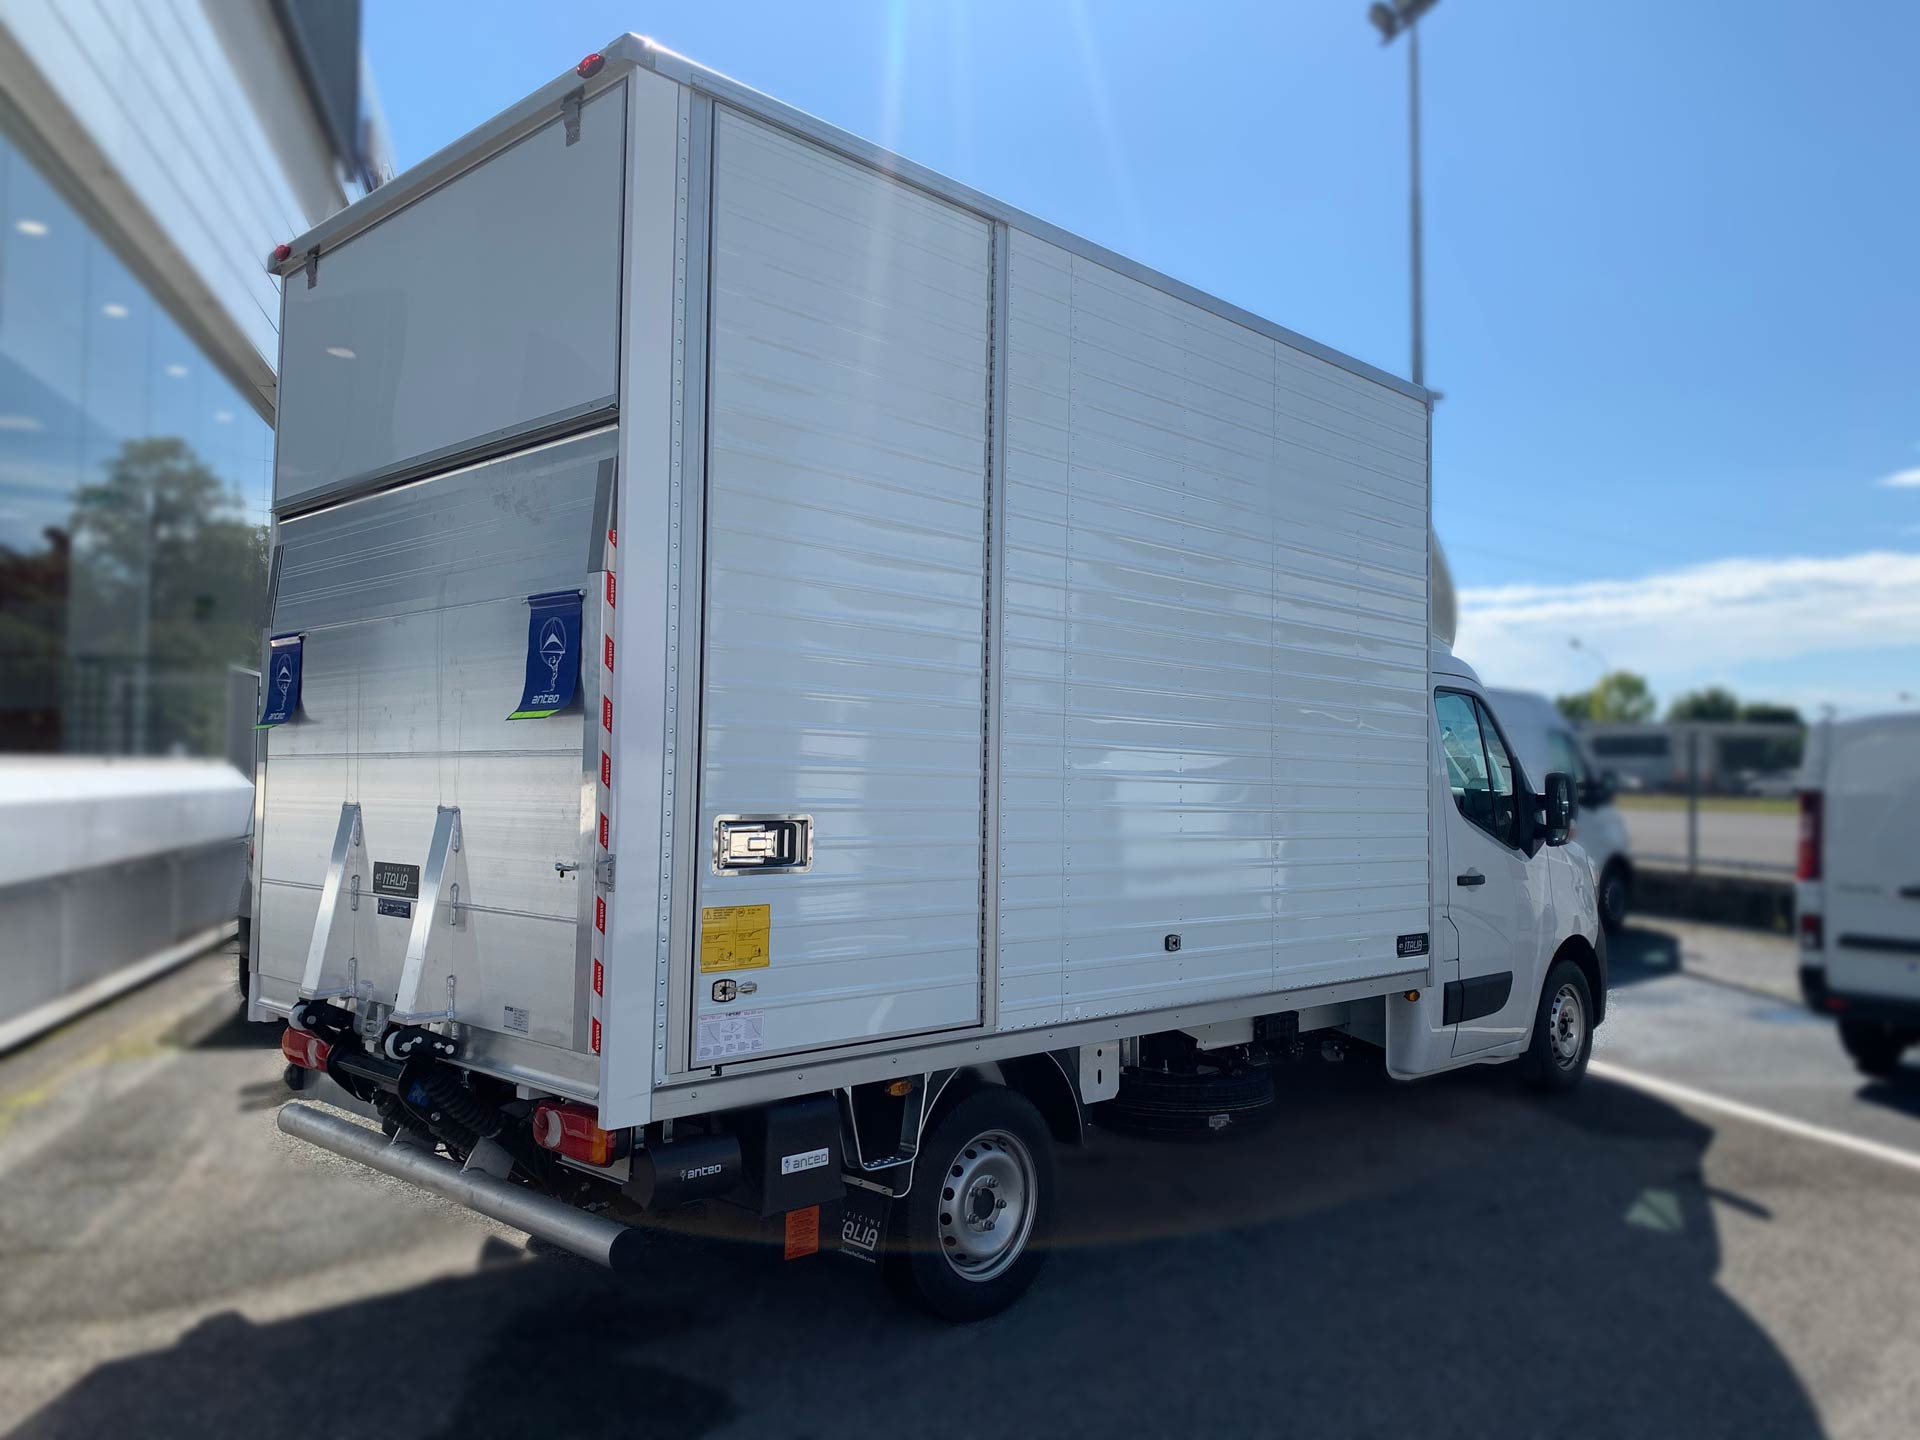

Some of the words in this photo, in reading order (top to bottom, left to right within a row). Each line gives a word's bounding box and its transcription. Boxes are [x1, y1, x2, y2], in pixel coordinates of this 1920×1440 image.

[531, 694, 560, 704] anteo
[382, 871, 409, 888] ITALIA
[1404, 940, 1423, 951] ITALIA
[793, 1152, 828, 1169] anteo
[687, 1164, 722, 1179] anteo
[844, 1210, 881, 1228] FICINE
[842, 1219, 878, 1249] ALIA
